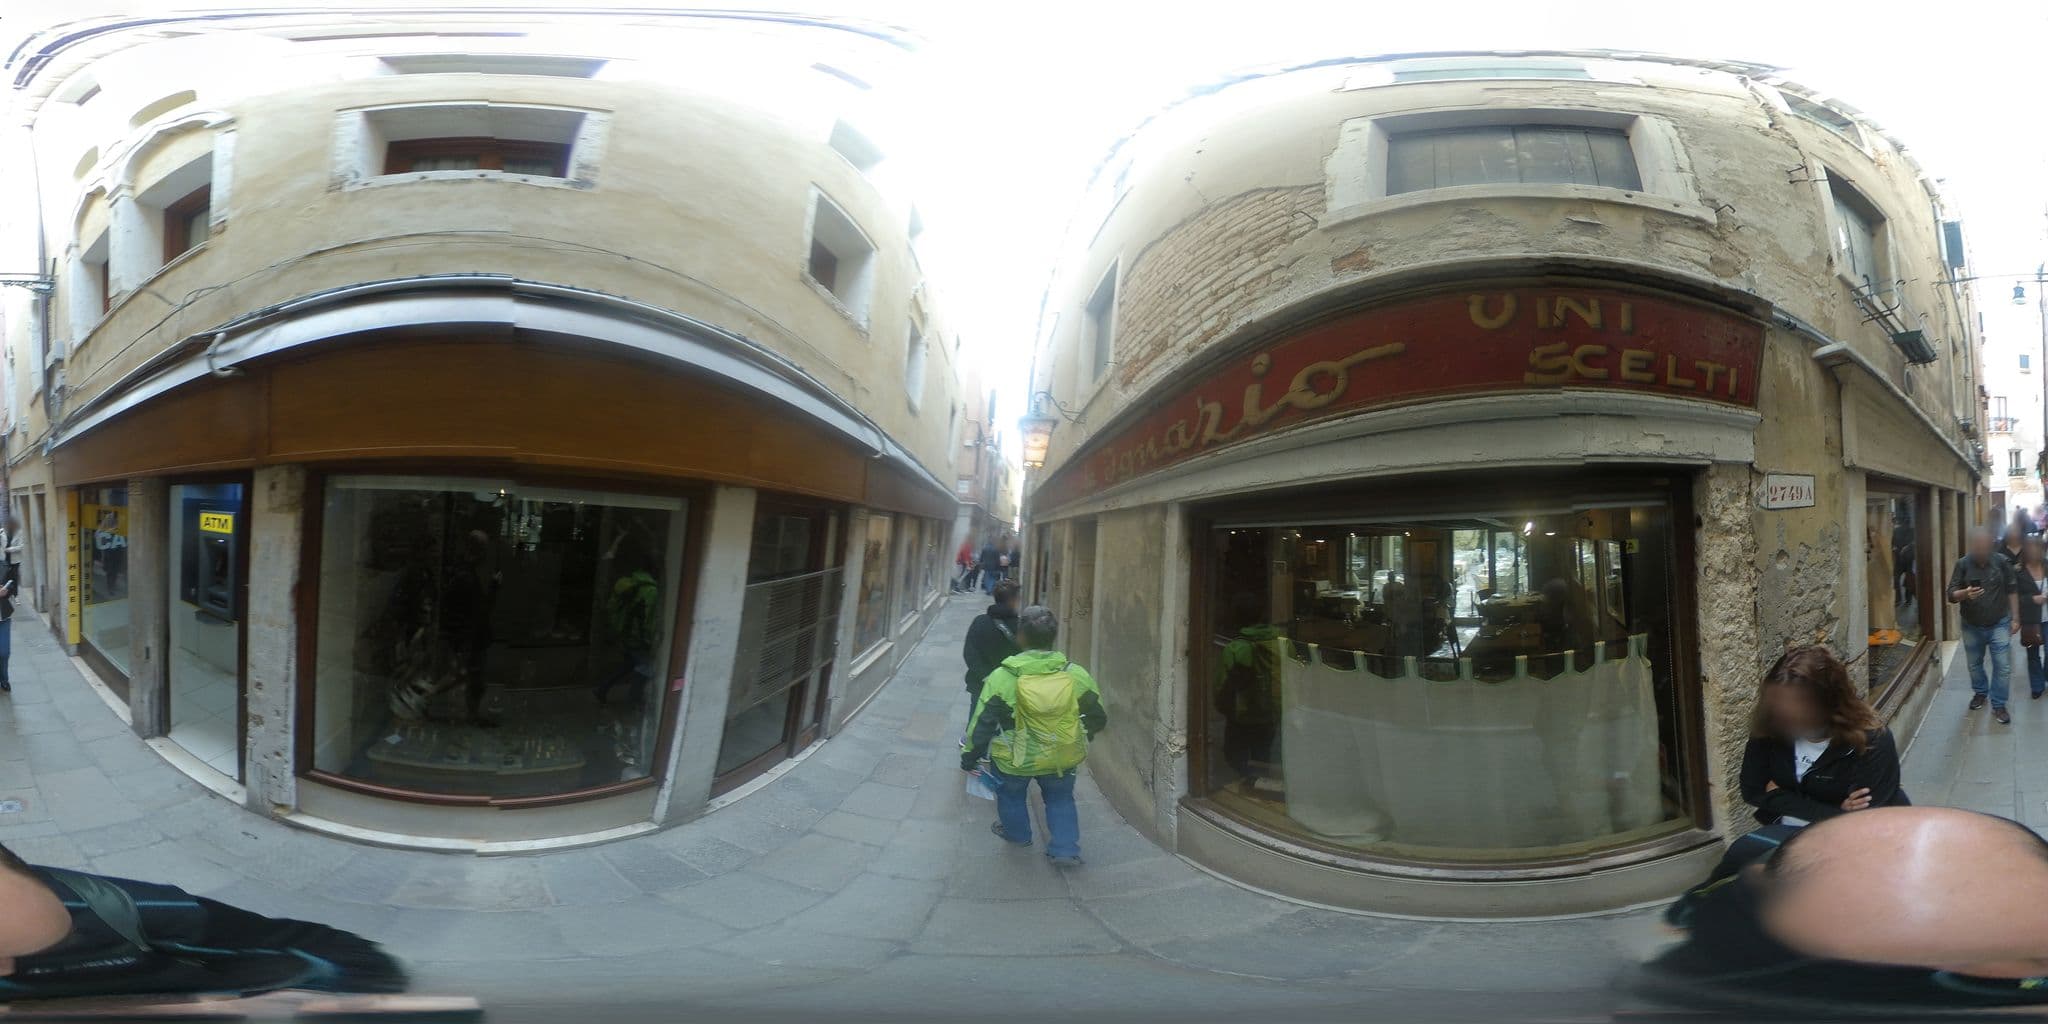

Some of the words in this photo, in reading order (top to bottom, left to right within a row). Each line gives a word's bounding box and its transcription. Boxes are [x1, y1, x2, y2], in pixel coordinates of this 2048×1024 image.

[1523, 341, 1738, 396] SCELTI
[1770, 485, 1812, 502] 2749A
[203, 517, 229, 529] ATM
